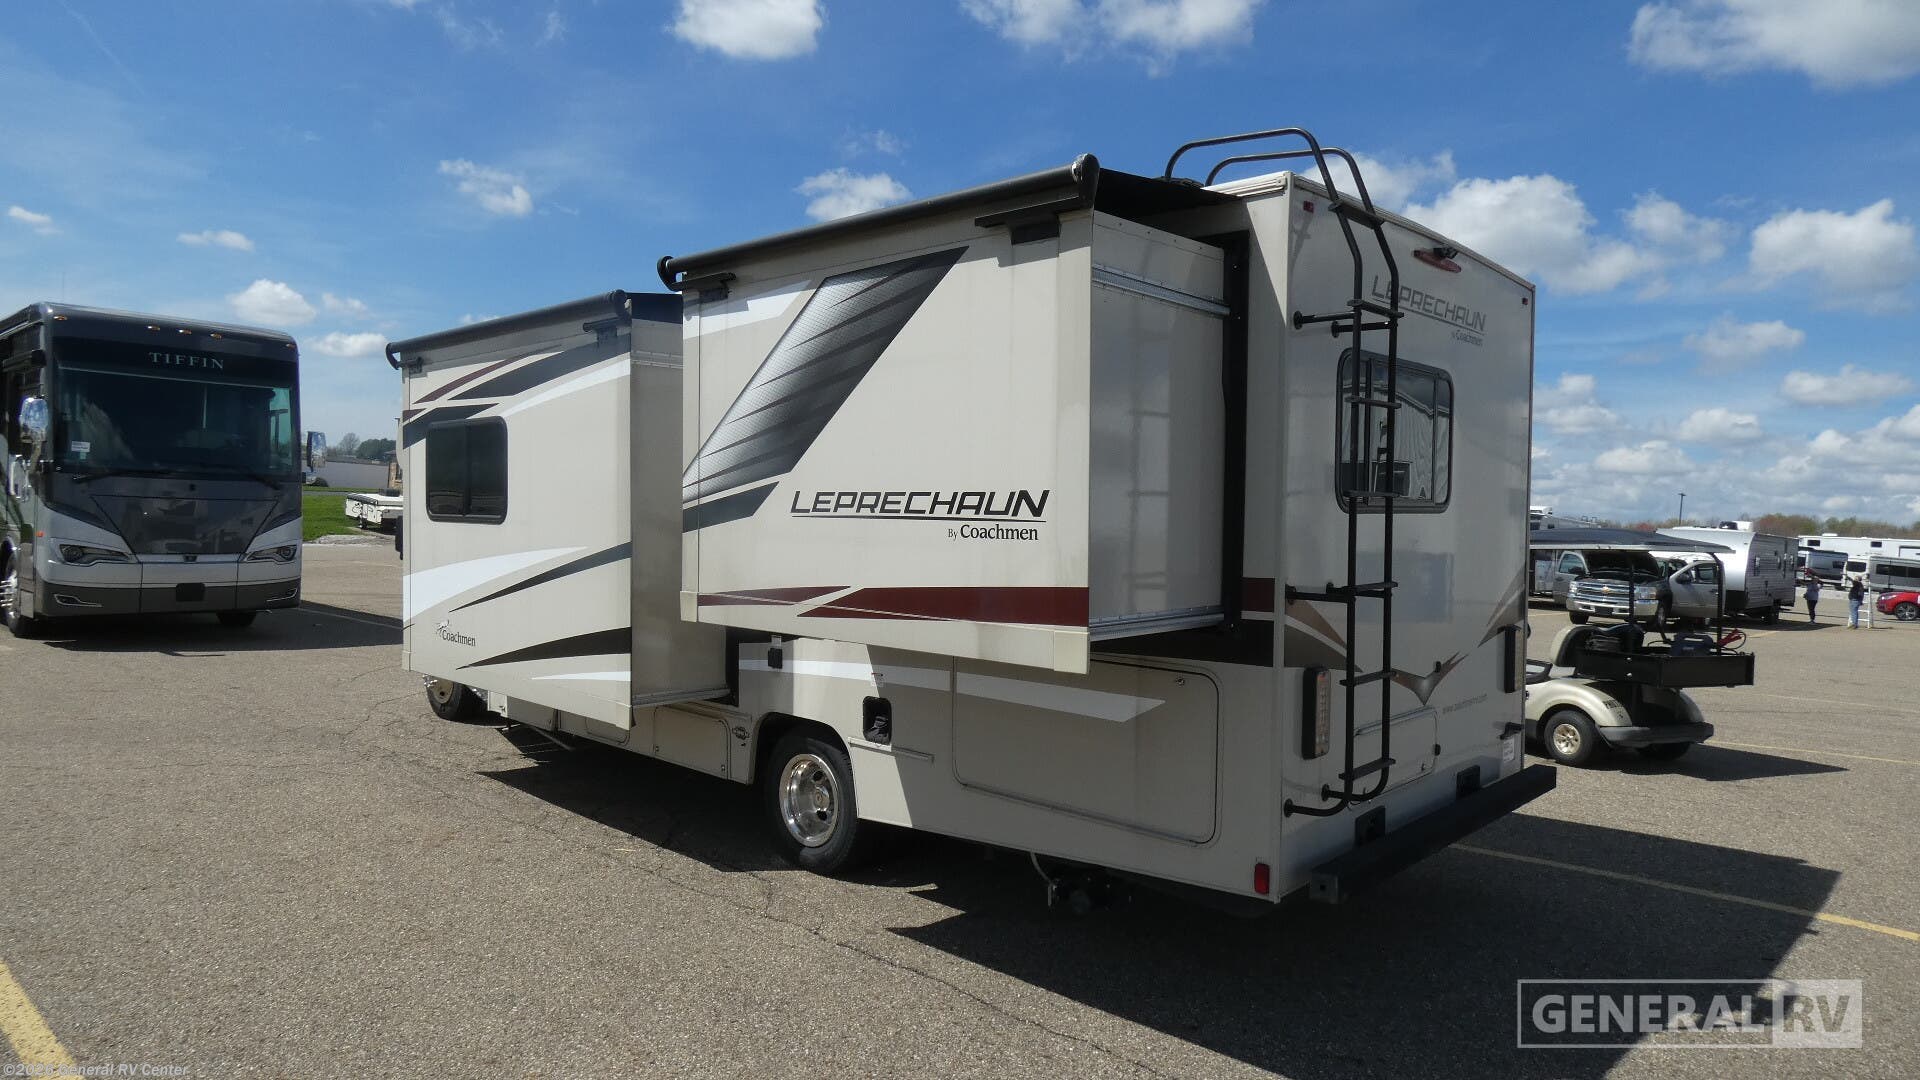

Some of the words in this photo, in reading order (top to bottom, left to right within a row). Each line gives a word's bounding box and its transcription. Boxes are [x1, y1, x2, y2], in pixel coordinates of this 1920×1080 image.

[148, 352, 224, 369] TIFFIN
[790, 489, 1050, 517] LEPRECHAUN
[948, 528, 957, 541] By
[960, 524, 1039, 541] Coachmen
[442, 629, 476, 647] Coachmen
